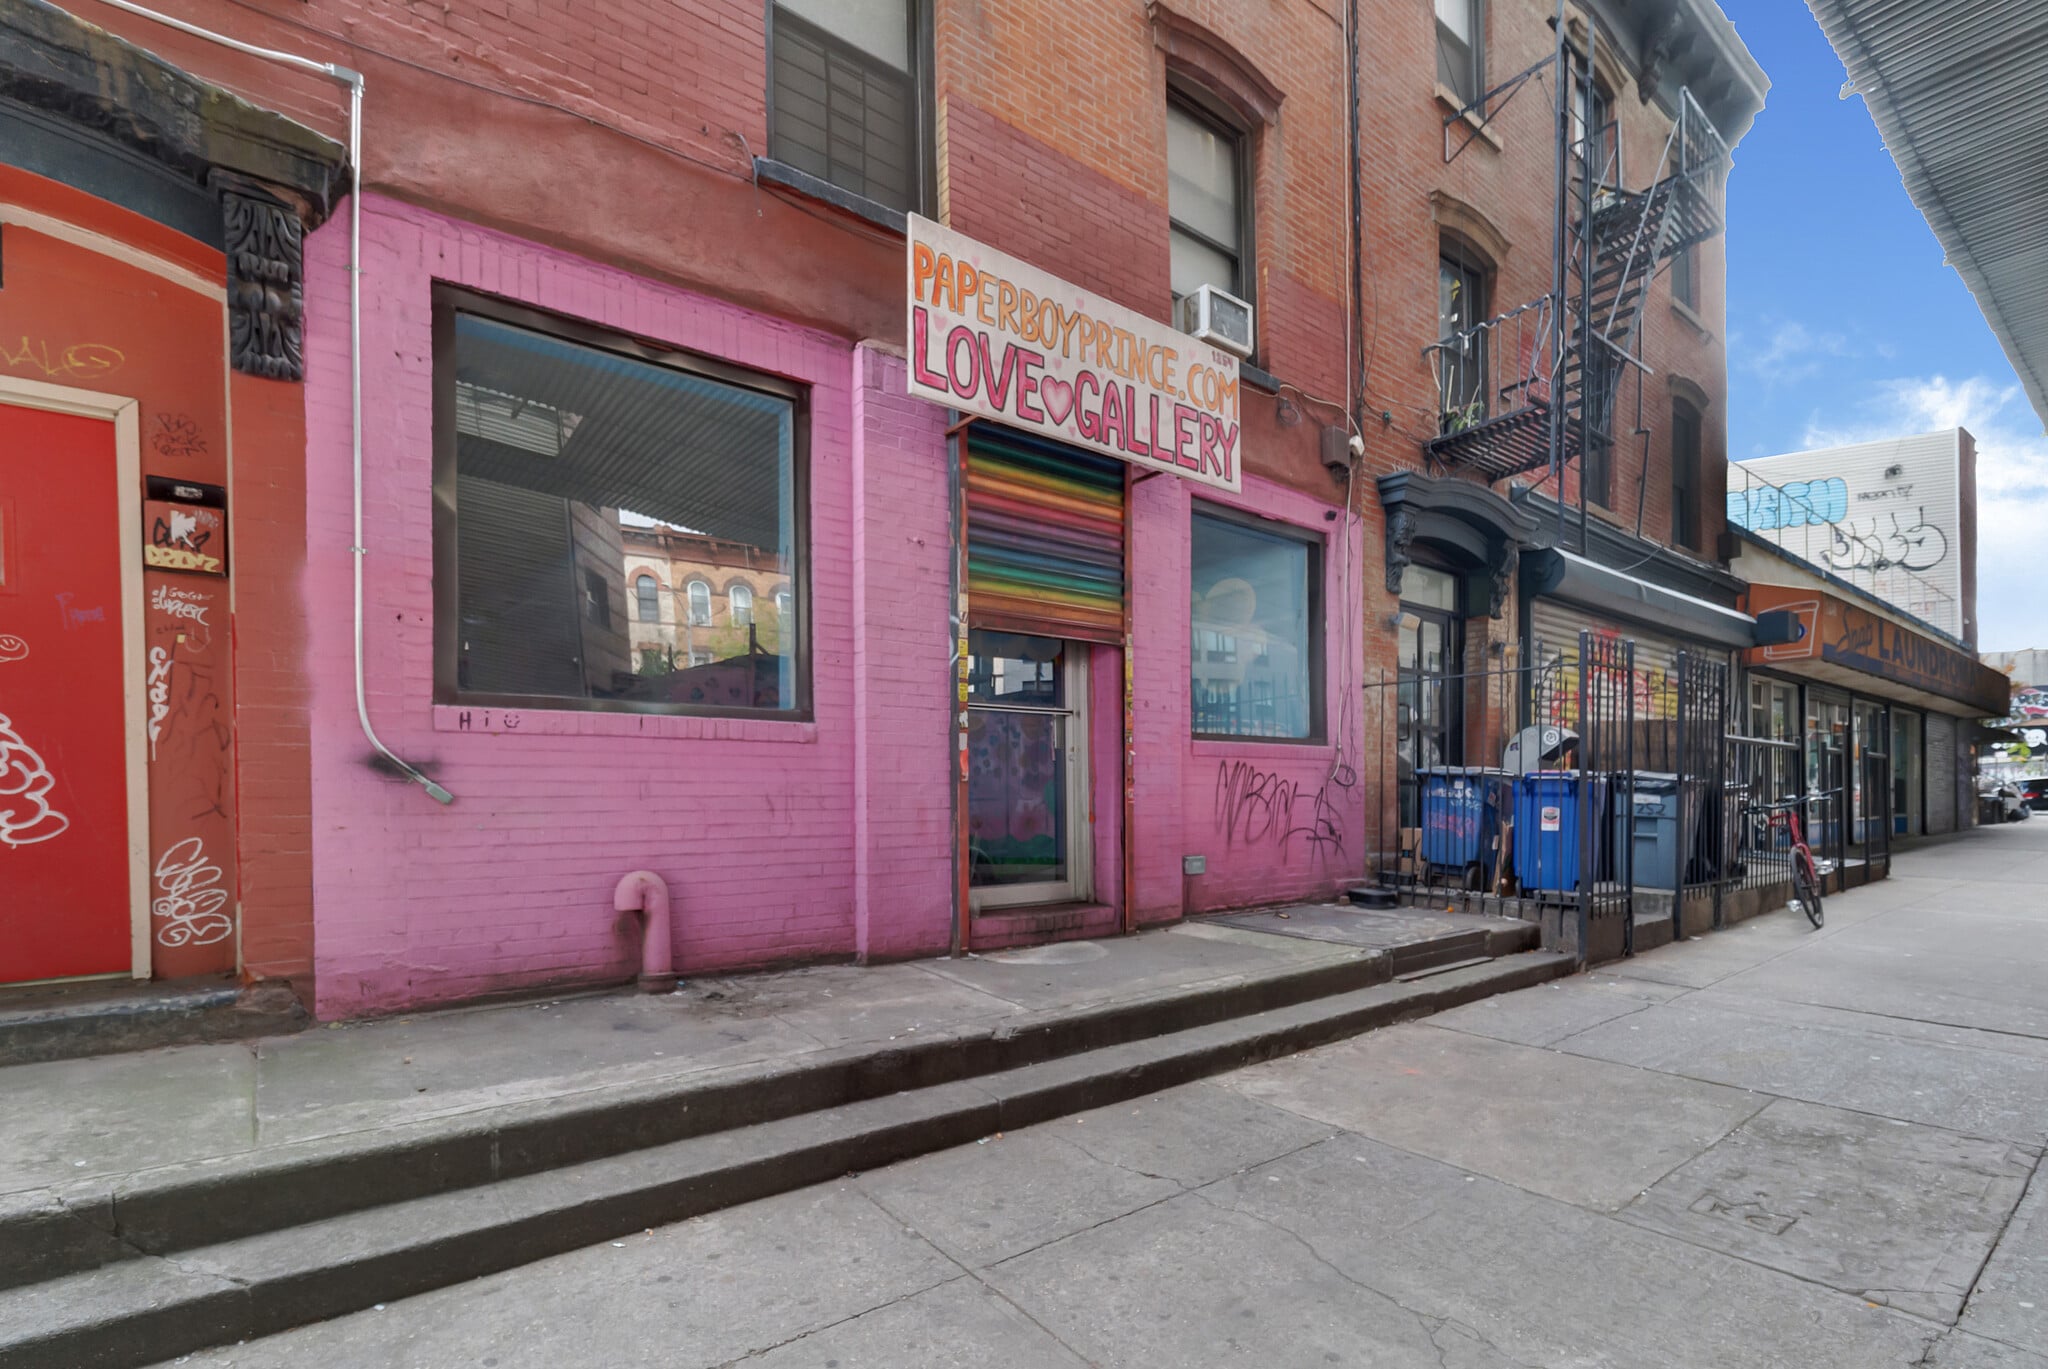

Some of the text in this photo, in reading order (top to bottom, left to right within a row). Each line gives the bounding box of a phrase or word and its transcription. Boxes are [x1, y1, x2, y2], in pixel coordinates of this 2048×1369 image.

[913, 305, 1239, 483] LOVE GALLERY
[914, 240, 1239, 421] PAPERBOYPRINCE.COM
[459, 711, 490, 730] Hi
